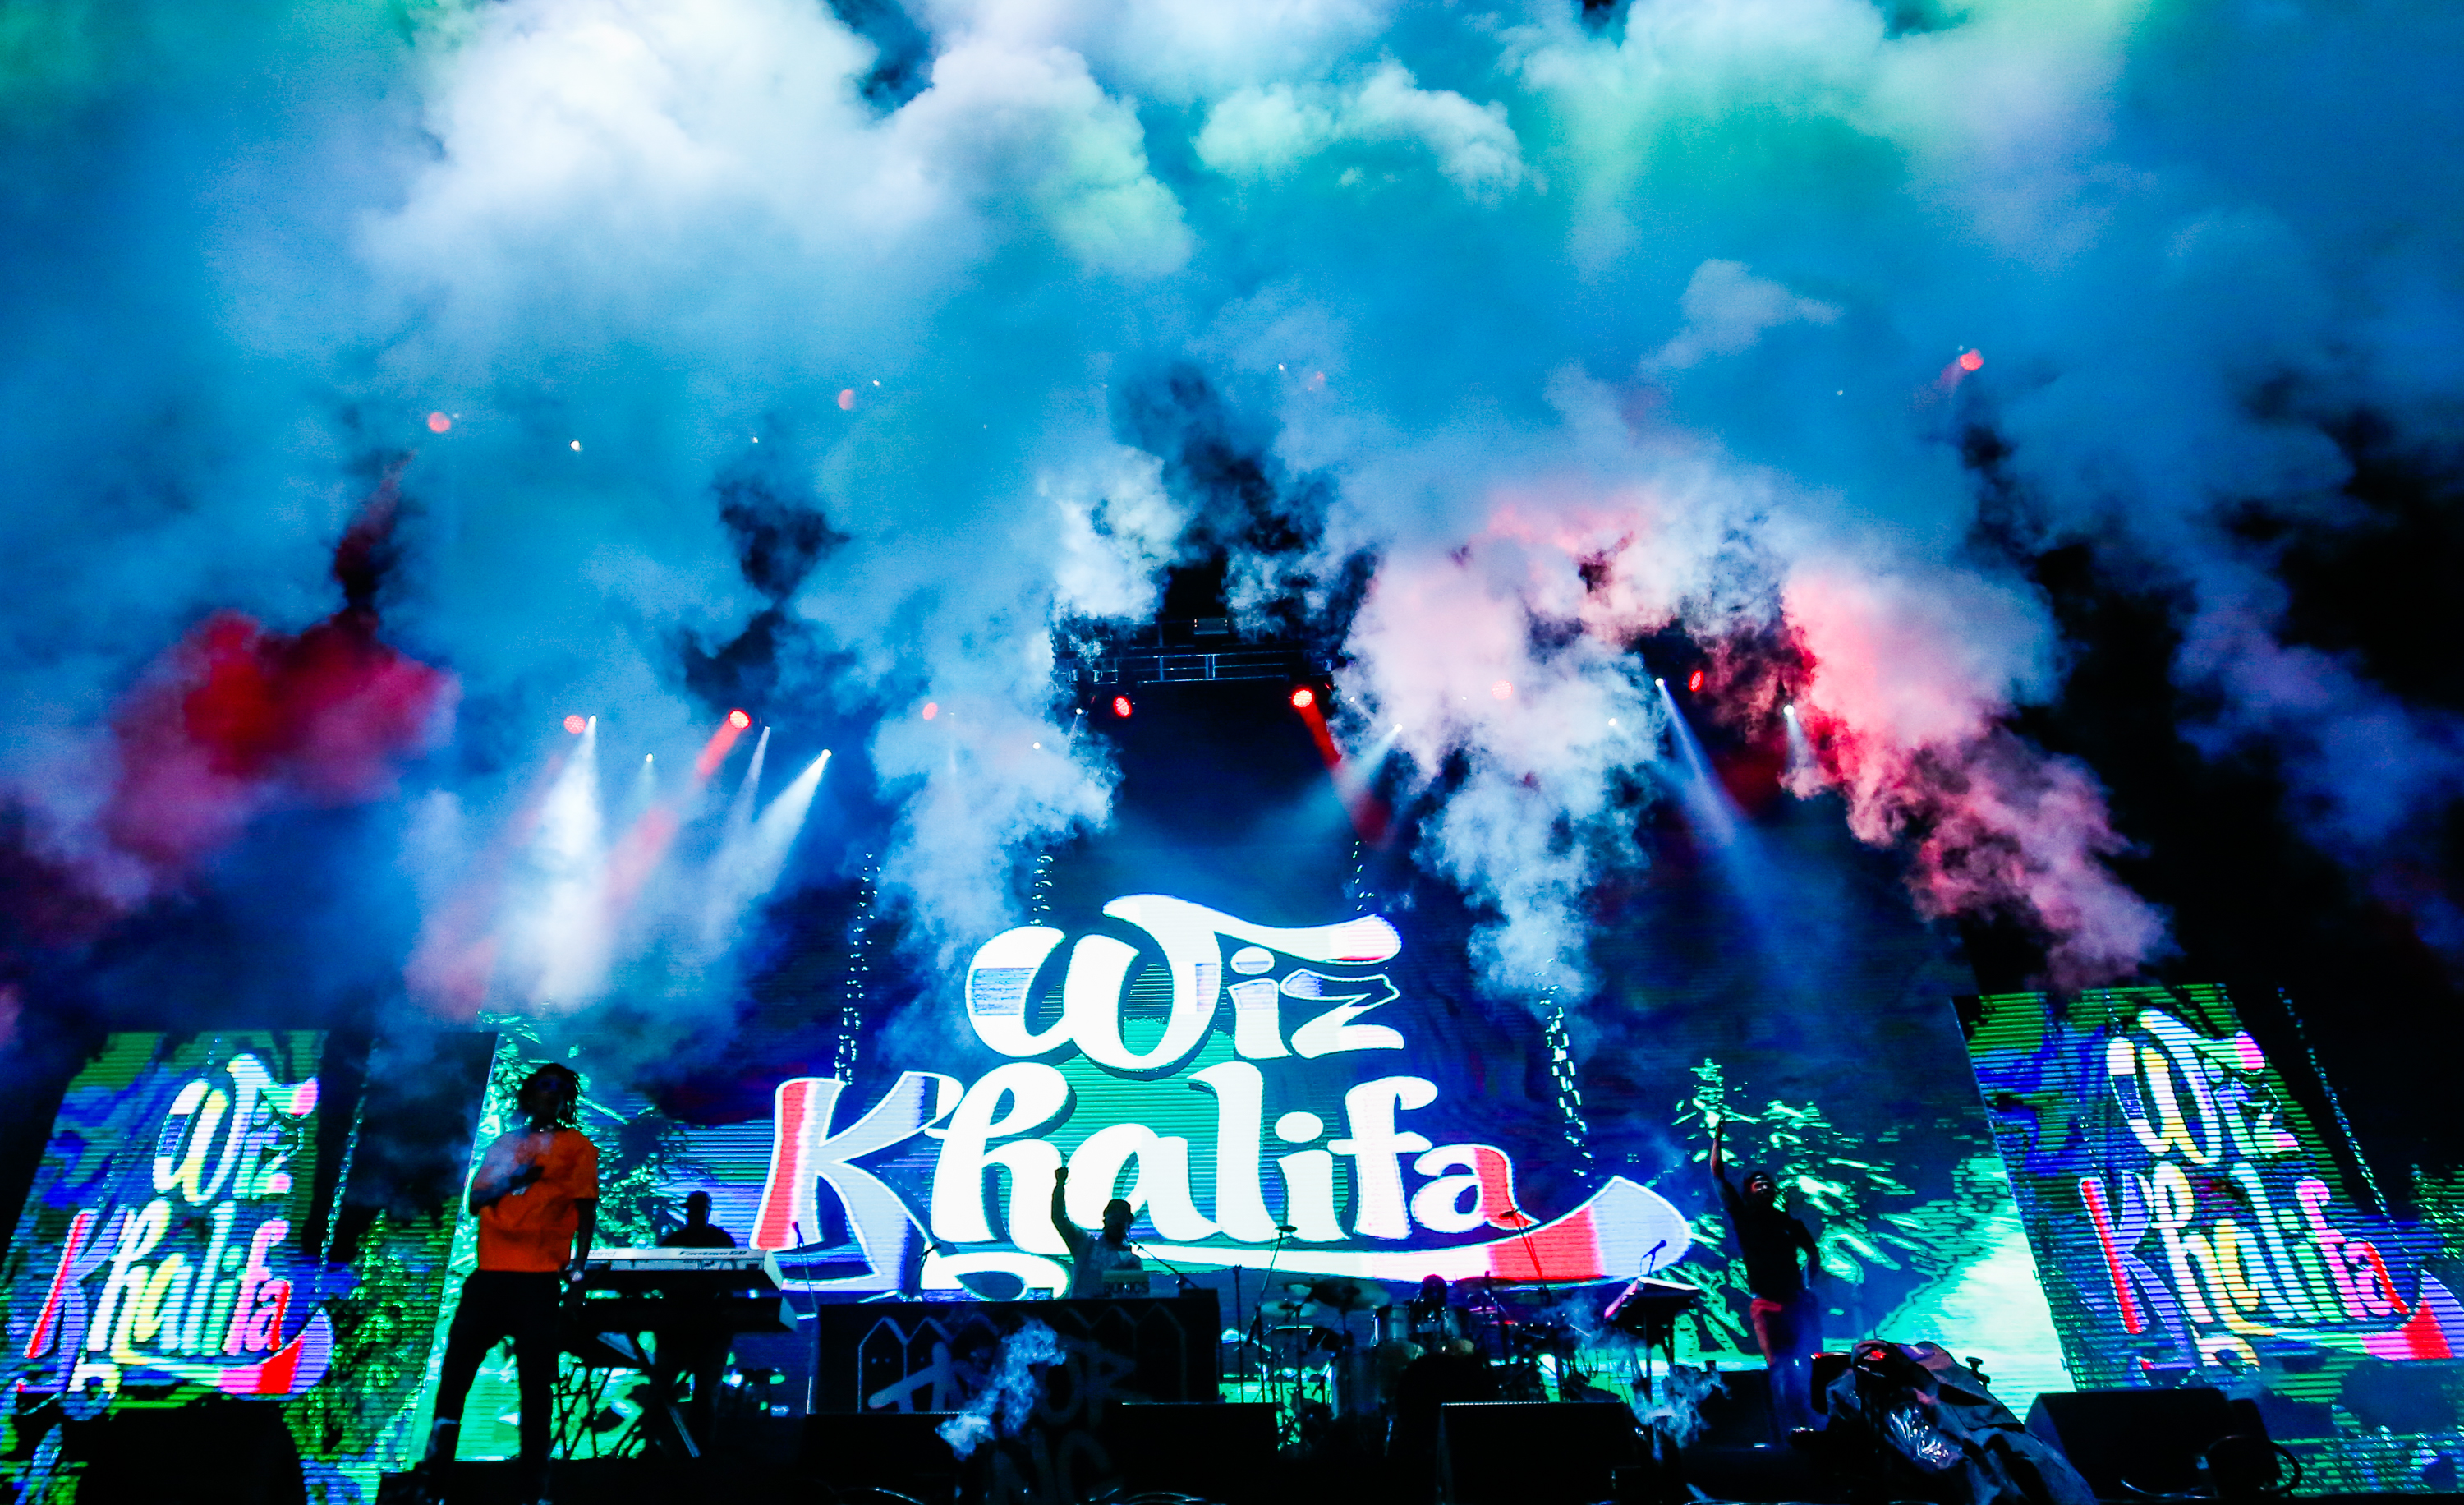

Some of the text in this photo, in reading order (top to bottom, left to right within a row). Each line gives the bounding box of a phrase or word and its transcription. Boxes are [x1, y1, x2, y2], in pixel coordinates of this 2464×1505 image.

[965, 894, 1405, 1070] Wiz
[154, 1054, 319, 1205] Wiz
[750, 1060, 1691, 1300] Khalifa
[2106, 1009, 2300, 1166] Wiz
[16, 1200, 333, 1402] Khalifa
[2079, 1160, 2464, 1380] Khalifa
